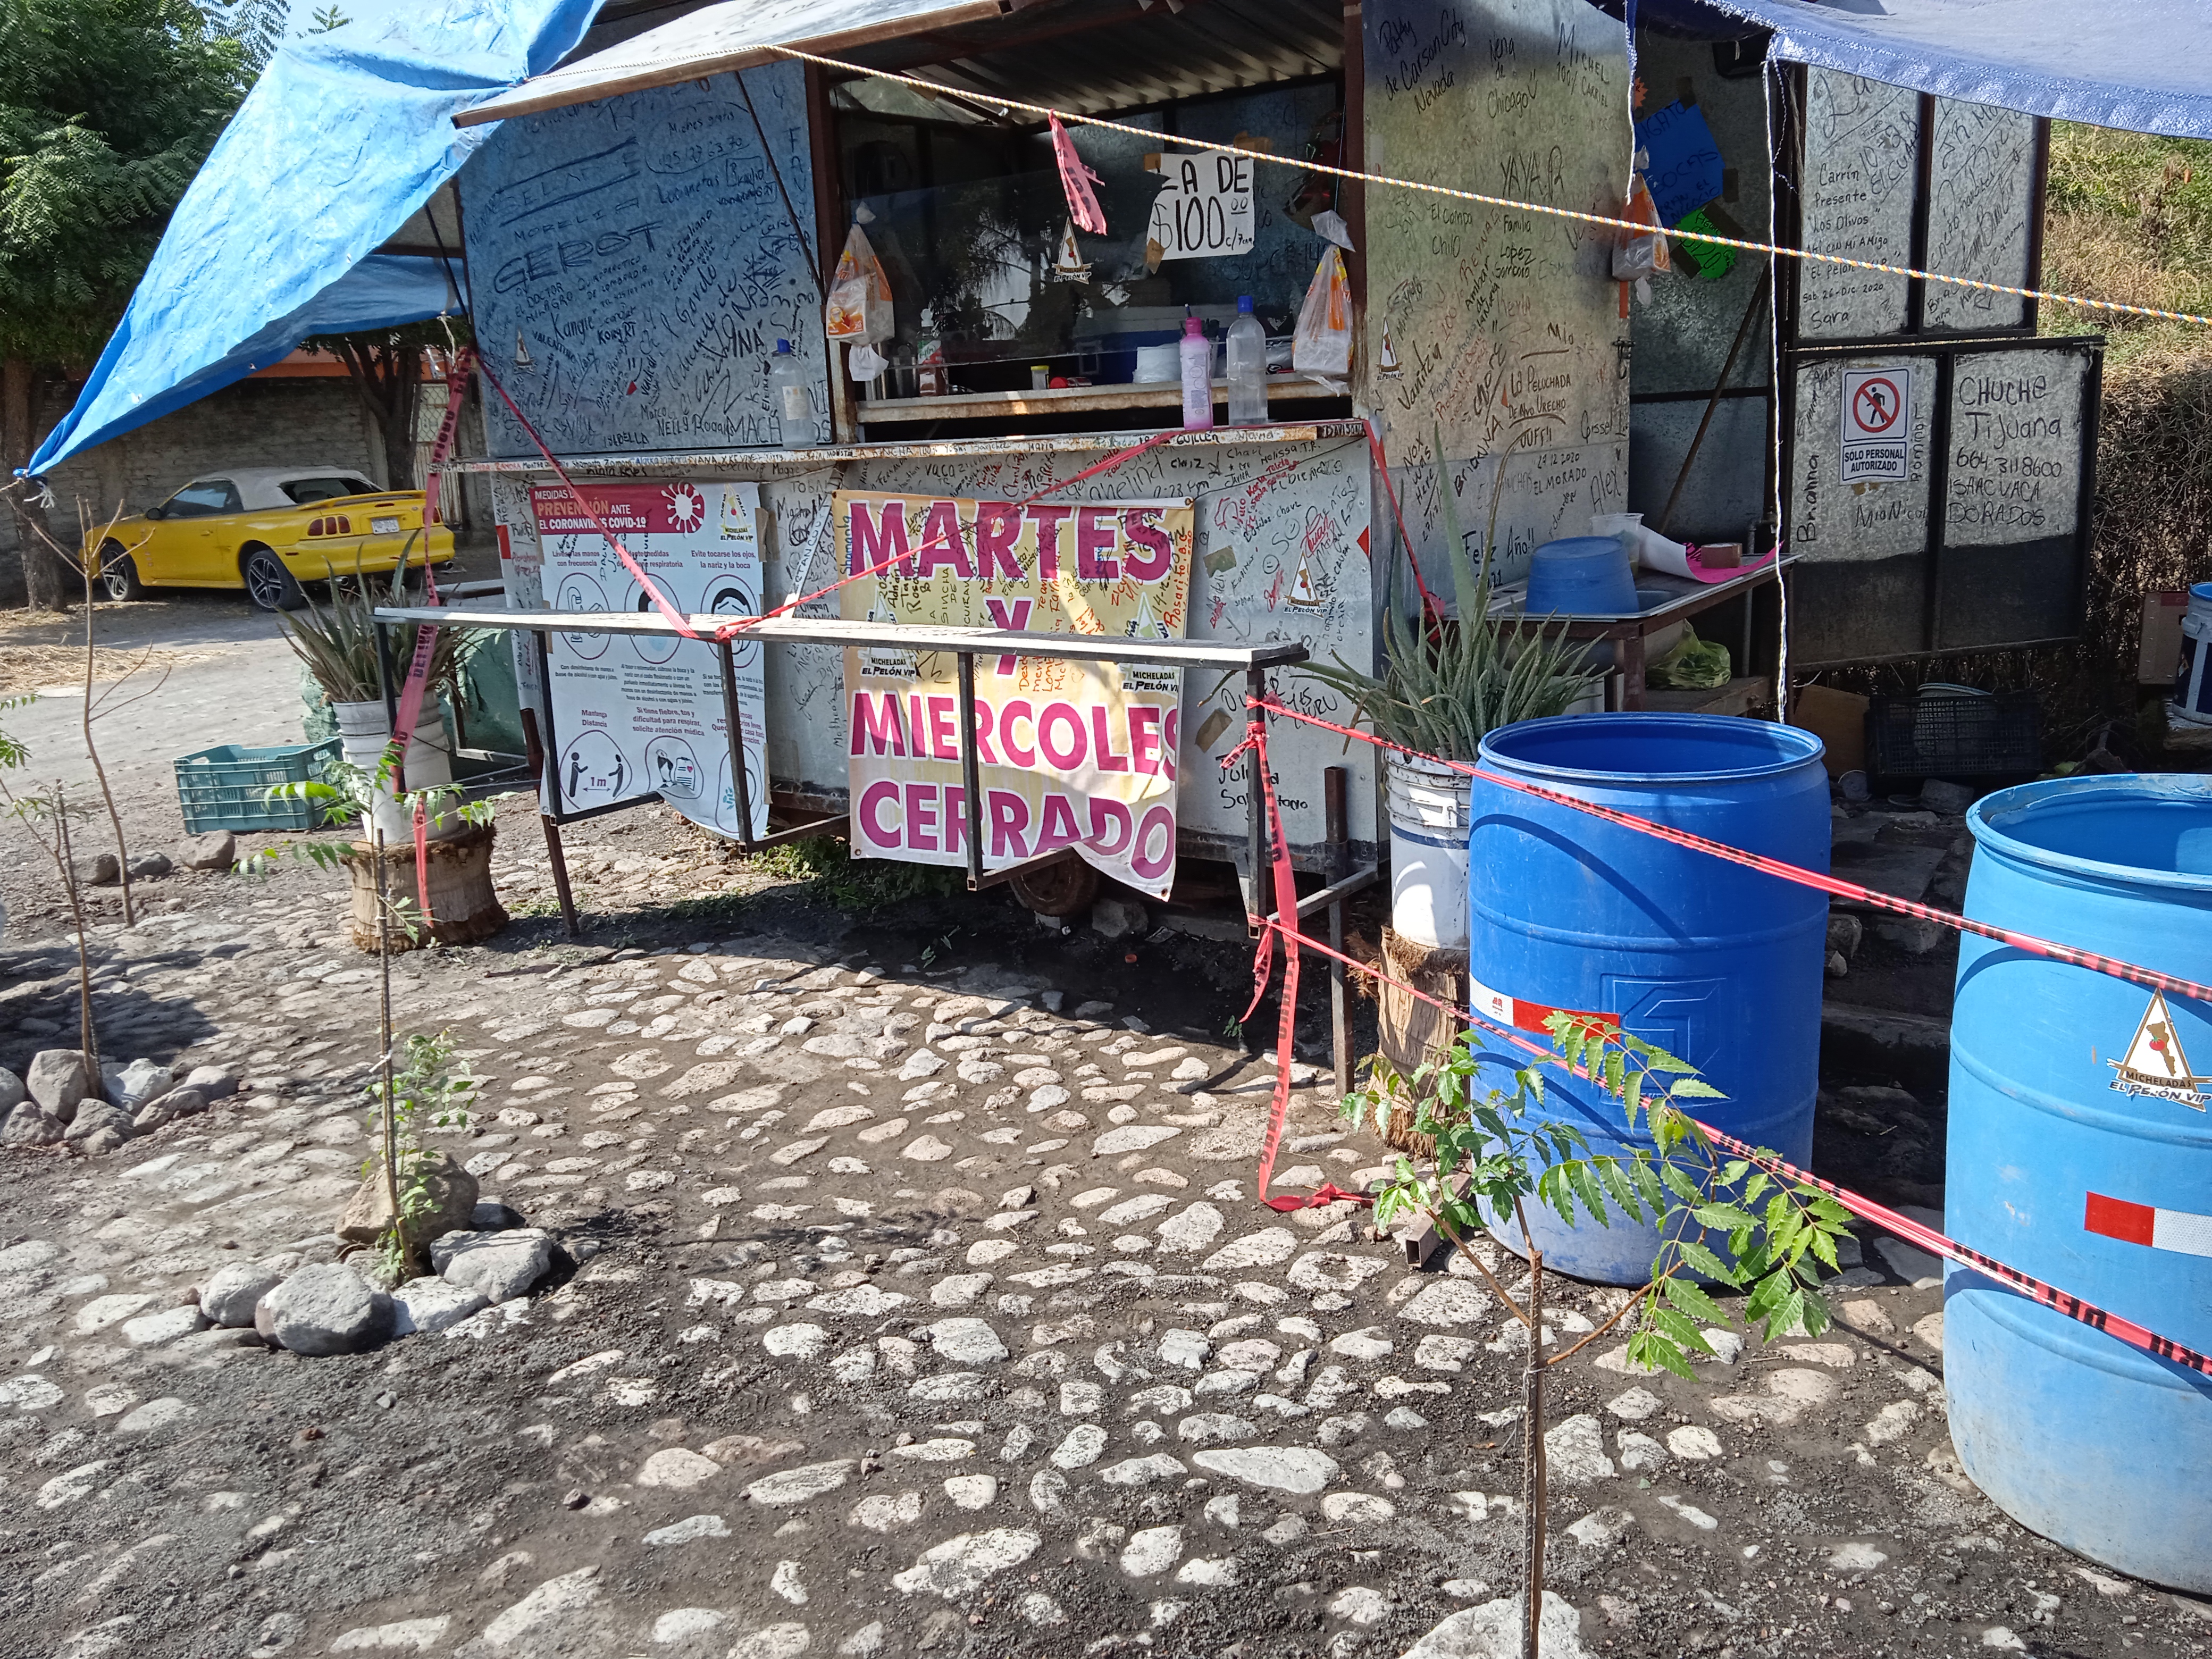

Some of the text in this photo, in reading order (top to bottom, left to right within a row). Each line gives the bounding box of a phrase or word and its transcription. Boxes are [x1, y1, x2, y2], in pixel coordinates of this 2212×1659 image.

[1216, 155, 1250, 194] DE
[1815, 191, 1867, 208] Presente
[1866, 448, 1904, 459] PERSONAL
[1850, 460, 1897, 473] AUTORIZADO
[535, 489, 568, 500] MEDIDAS
[537, 497, 632, 516] PREVENIÓN ANTE
[539, 516, 647, 530] EL CORONAVIRS COVID-19
[850, 502, 1171, 581] MARTES
[1461, 530, 1497, 564] Felz
[691, 549, 706, 558] Evite
[1292, 605, 1316, 614] PELÓN
[987, 600, 1032, 675] Y
[871, 657, 906, 666] MICHELADAS
[872, 665, 903, 677] PELÓN
[1132, 670, 1175, 681] MICHELADAS
[1122, 681, 1134, 691] EL
[1134, 678, 1168, 692] PELÓN
[859, 780, 1176, 879] CERRADO
[2125, 1070, 2192, 1088] MICHELADAS
[2109, 1081, 2126, 1091] EL
[2186, 1093, 2212, 1104] VIP
